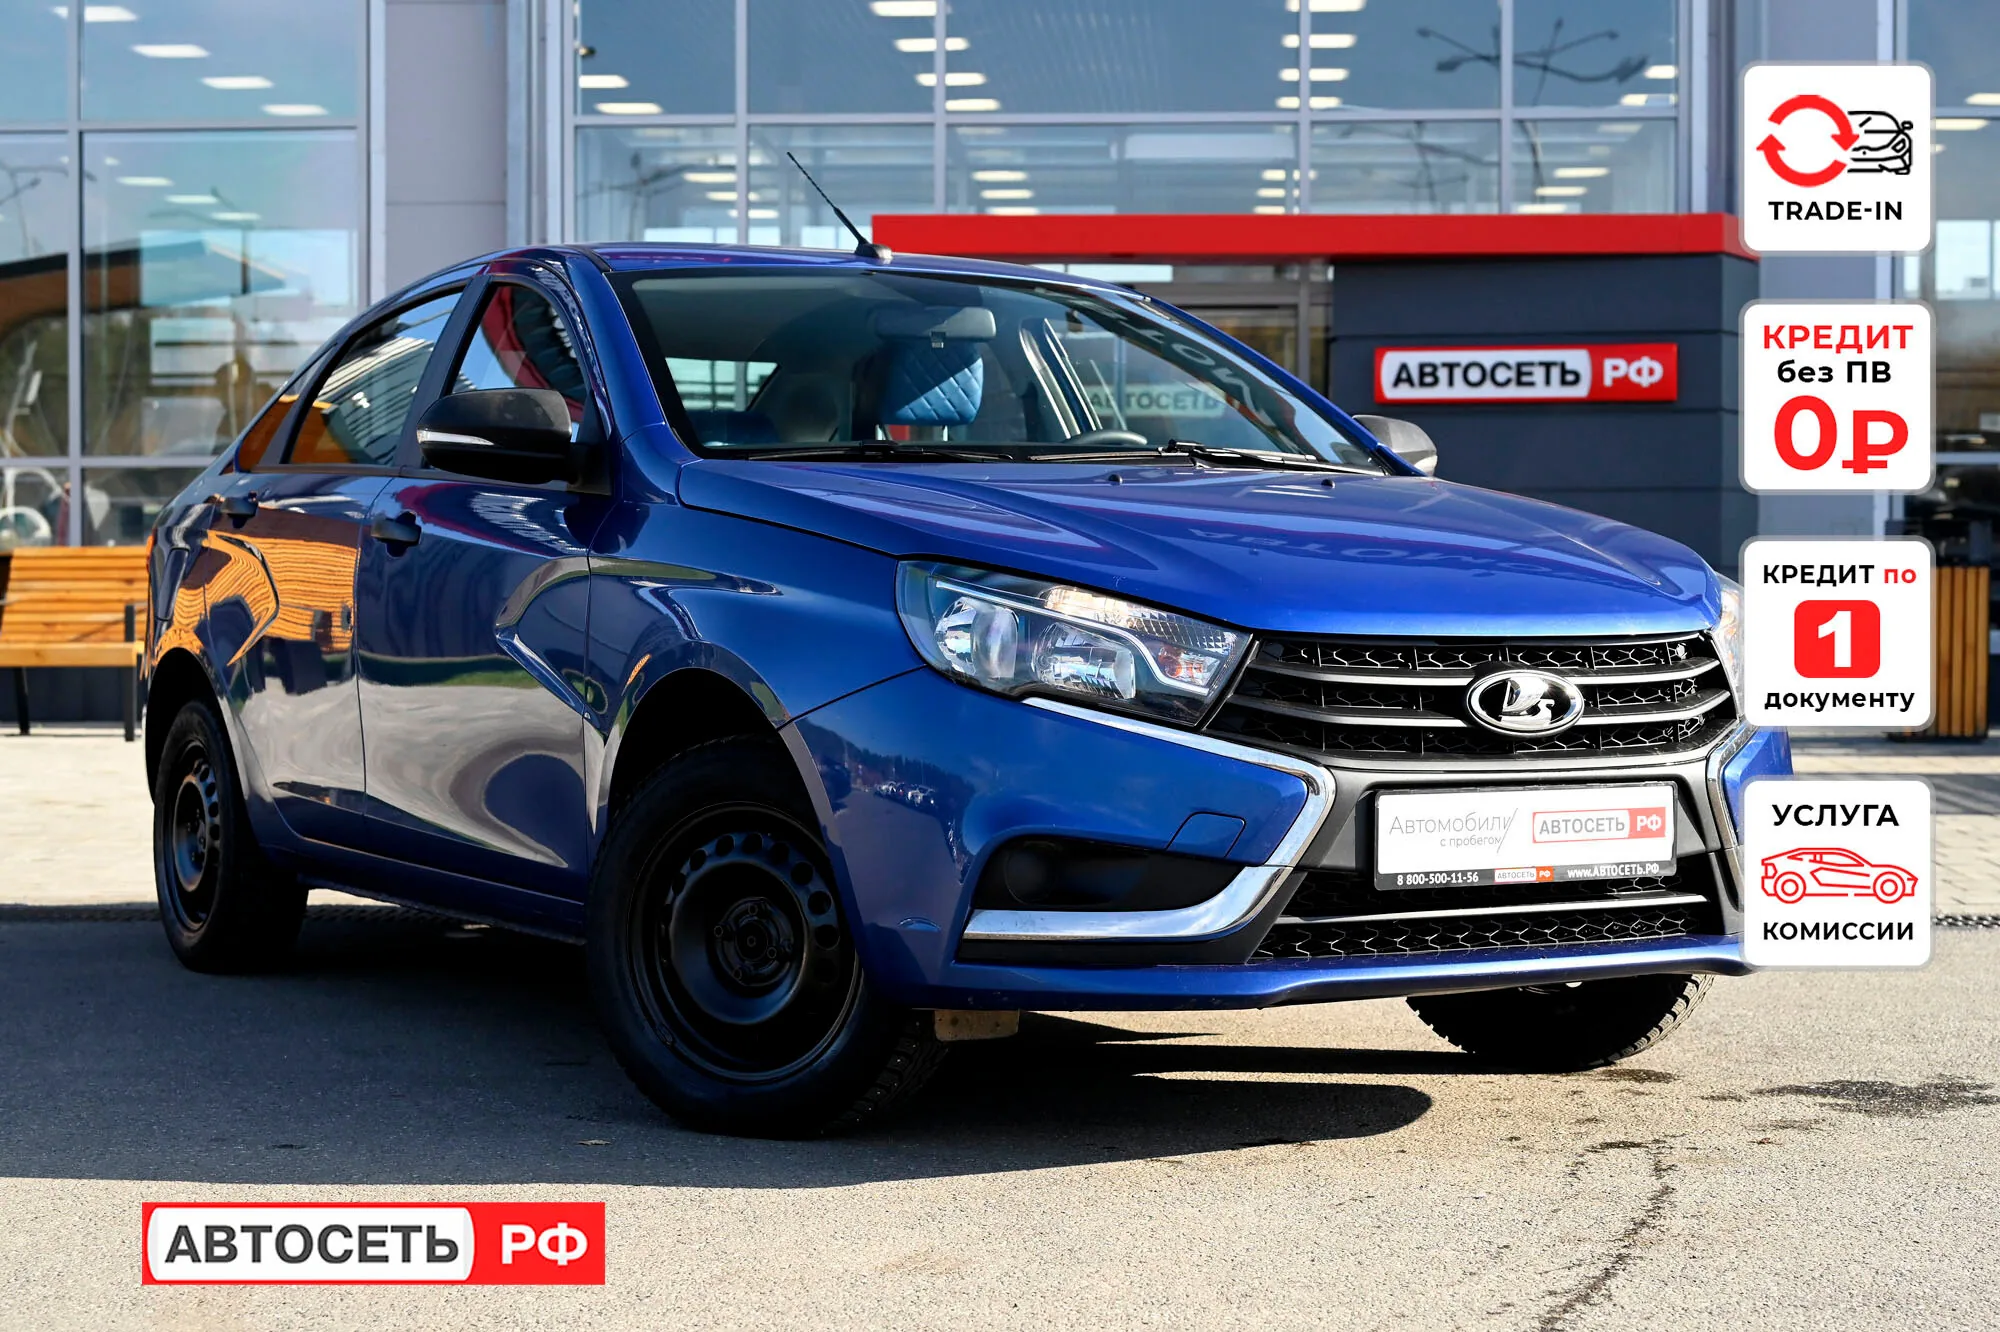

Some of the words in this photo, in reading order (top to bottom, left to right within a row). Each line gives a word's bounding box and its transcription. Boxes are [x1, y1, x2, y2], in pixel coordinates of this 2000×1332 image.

[1392, 361, 1581, 389] АВТОСЕТЬ
[1603, 356, 1664, 388] РФ
[1539, 816, 1625, 835] АВТОСЕТЬ
[1636, 814, 1662, 832] РФ
[1439, 838, 1446, 847] с
[1497, 870, 1535, 880] АВТОСЕТЬ
[1539, 870, 1551, 879] РФ
[1567, 863, 1660, 878] www.АВТОСЕТЬ.РФ
[1397, 876, 1404, 886] 8
[1406, 872, 1479, 885] 800-500-11-56
